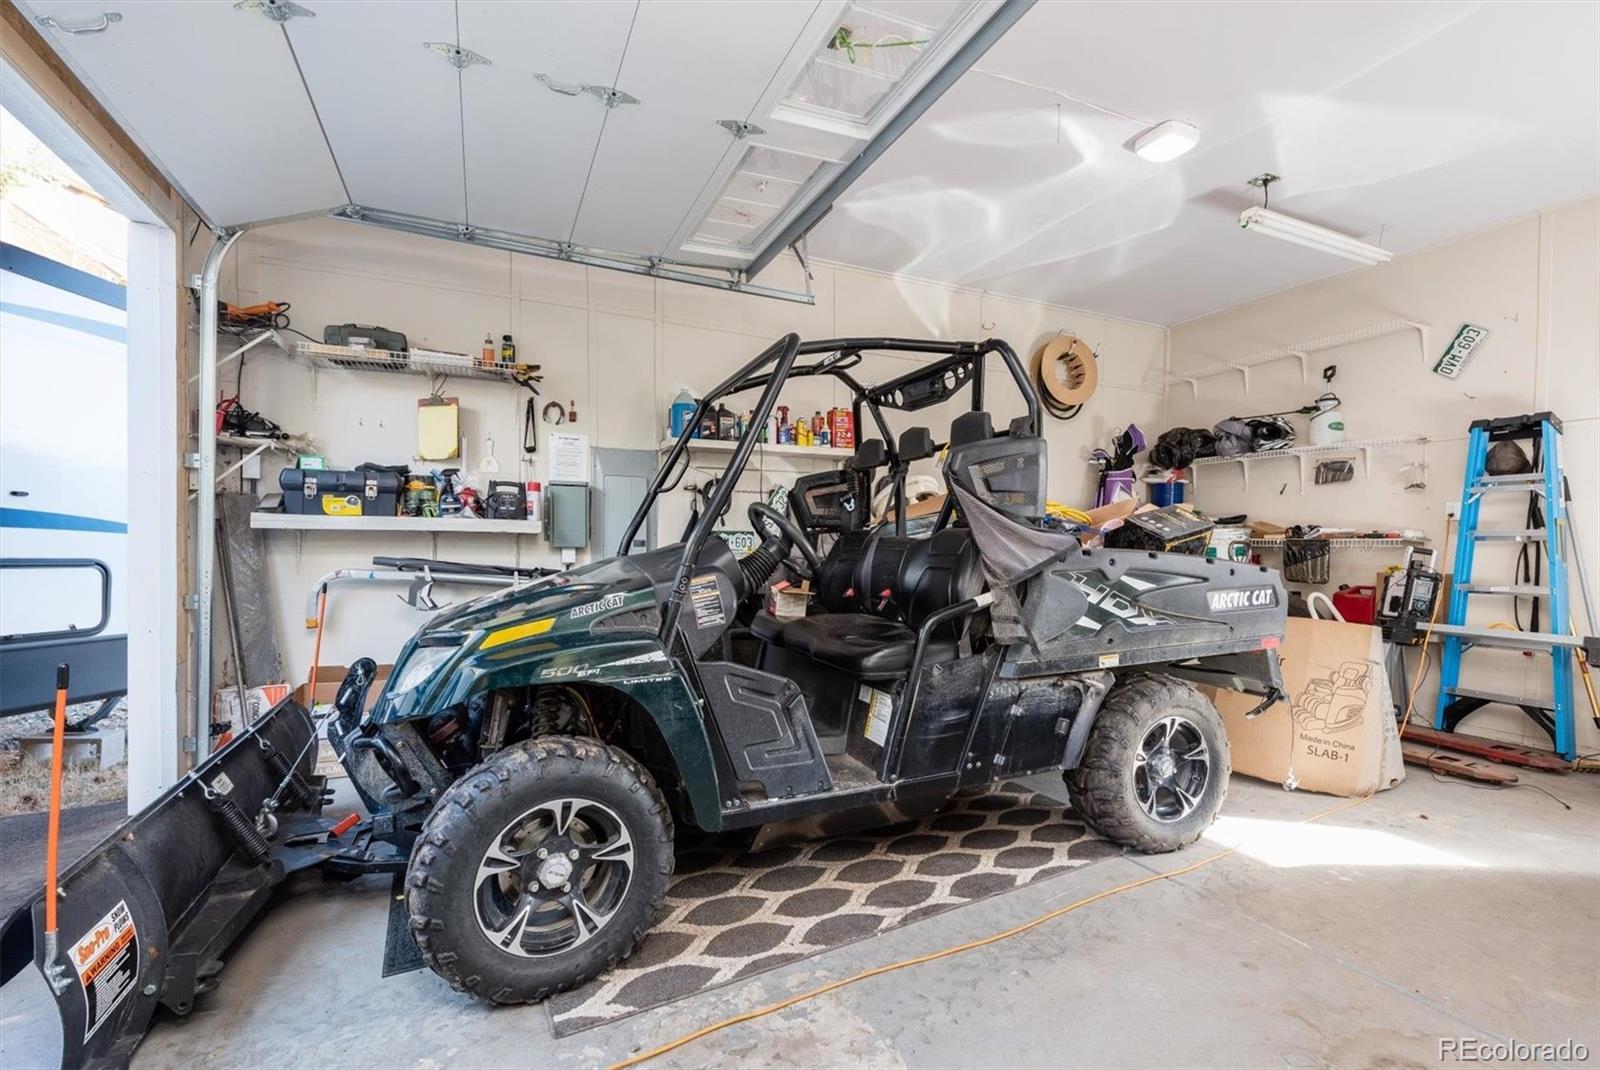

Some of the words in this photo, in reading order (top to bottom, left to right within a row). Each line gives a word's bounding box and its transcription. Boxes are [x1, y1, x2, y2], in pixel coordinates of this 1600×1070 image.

[570, 599, 606, 619] ARCTIC
[605, 595, 625, 609] CAT
[1211, 590, 1249, 610] ARCTIC
[1252, 588, 1272, 606] CAT
[623, 676, 672, 685] LIMITED
[1300, 733, 1322, 744] Made
[1332, 740, 1356, 751] China
[1306, 745, 1349, 762] SLAB-1
[90, 942, 120, 976] WARNING
